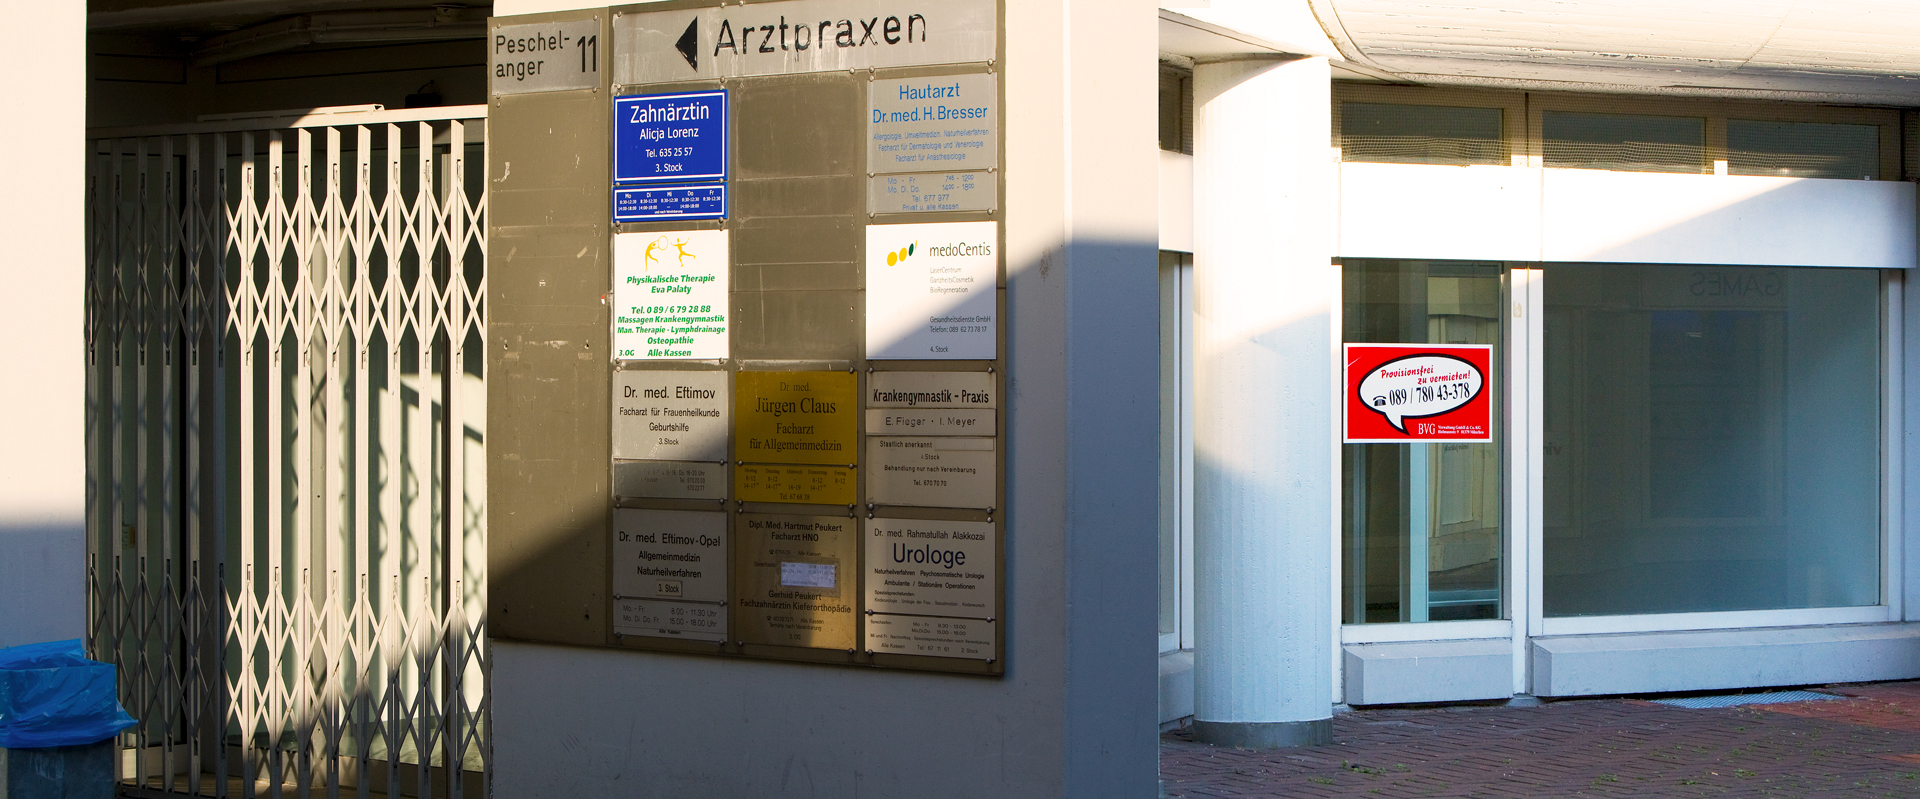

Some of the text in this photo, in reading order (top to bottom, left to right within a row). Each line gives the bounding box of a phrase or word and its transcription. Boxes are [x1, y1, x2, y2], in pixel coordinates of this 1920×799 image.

[496, 31, 569, 54] Peschel-
[714, 14, 927, 62] Arztpraxen
[577, 35, 598, 73] 11
[496, 59, 543, 81] anger
[900, 83, 960, 100] Hautarzt
[630, 102, 709, 123] Zahnärztin
[873, 106, 987, 123] Dr. med. H. Bresser
[640, 127, 699, 141] Alicja Lorenz
[909, 142, 941, 151] Dermatologie
[954, 140, 983, 148] Venerologie
[646, 147, 692, 157] Tel. 635 25 57
[656, 163, 682, 172] 3. Stock
[930, 242, 991, 256] medoCentis
[627, 274, 715, 285] Physikalische Therapie
[666, 285, 691, 294] Palaty
[618, 315, 724, 325] Massagen Krankengymnastik
[671, 326, 725, 334] Lymphdrainage
[647, 336, 694, 346] Osteopathie
[1381, 365, 1434, 379] Provisionsfrei
[1430, 370, 1470, 383] vermieten!
[624, 386, 715, 399] Dr. med. Eftimov
[780, 382, 811, 392] Dr. med.
[873, 389, 952, 405] Krankengymnastik
[962, 390, 989, 403] Praxis
[1389, 388, 1406, 405] 089
[1416, 386, 1434, 403] 780
[1437, 382, 1470, 401] 43-378
[620, 407, 720, 417] Facharzt für Frauenheilkunde
[756, 397, 836, 417] Jürgen Claus
[649, 422, 689, 432] Geburtshilfe
[886, 417, 893, 425] E.
[940, 417, 944, 425] I.
[948, 417, 976, 427] Meyer
[776, 423, 814, 434] Facharzt
[1418, 423, 1435, 435] BVG
[750, 438, 842, 452] für Allgemeinmedizin
[749, 521, 763, 529] Dipl.
[784, 522, 813, 530] Hartmut
[815, 523, 842, 531] Peukert
[619, 531, 630, 542] Dr.
[636, 533, 656, 543] med.
[772, 532, 800, 541] Facharzt
[874, 528, 883, 536] Dr.
[907, 530, 948, 539] Rahmatullah
[952, 532, 985, 540] Alakkozai
[639, 551, 700, 562] Allgemeinmedizin
[894, 543, 965, 569] Urologe
[637, 566, 701, 578] Naturheilverfahren
[920, 570, 962, 578] Psychosomatische
[658, 584, 679, 593] 3. Stock
[768, 590, 822, 600] Gerhild Peukert
[740, 599, 851, 613] Fachzahnärztin Kieferorthopädie
